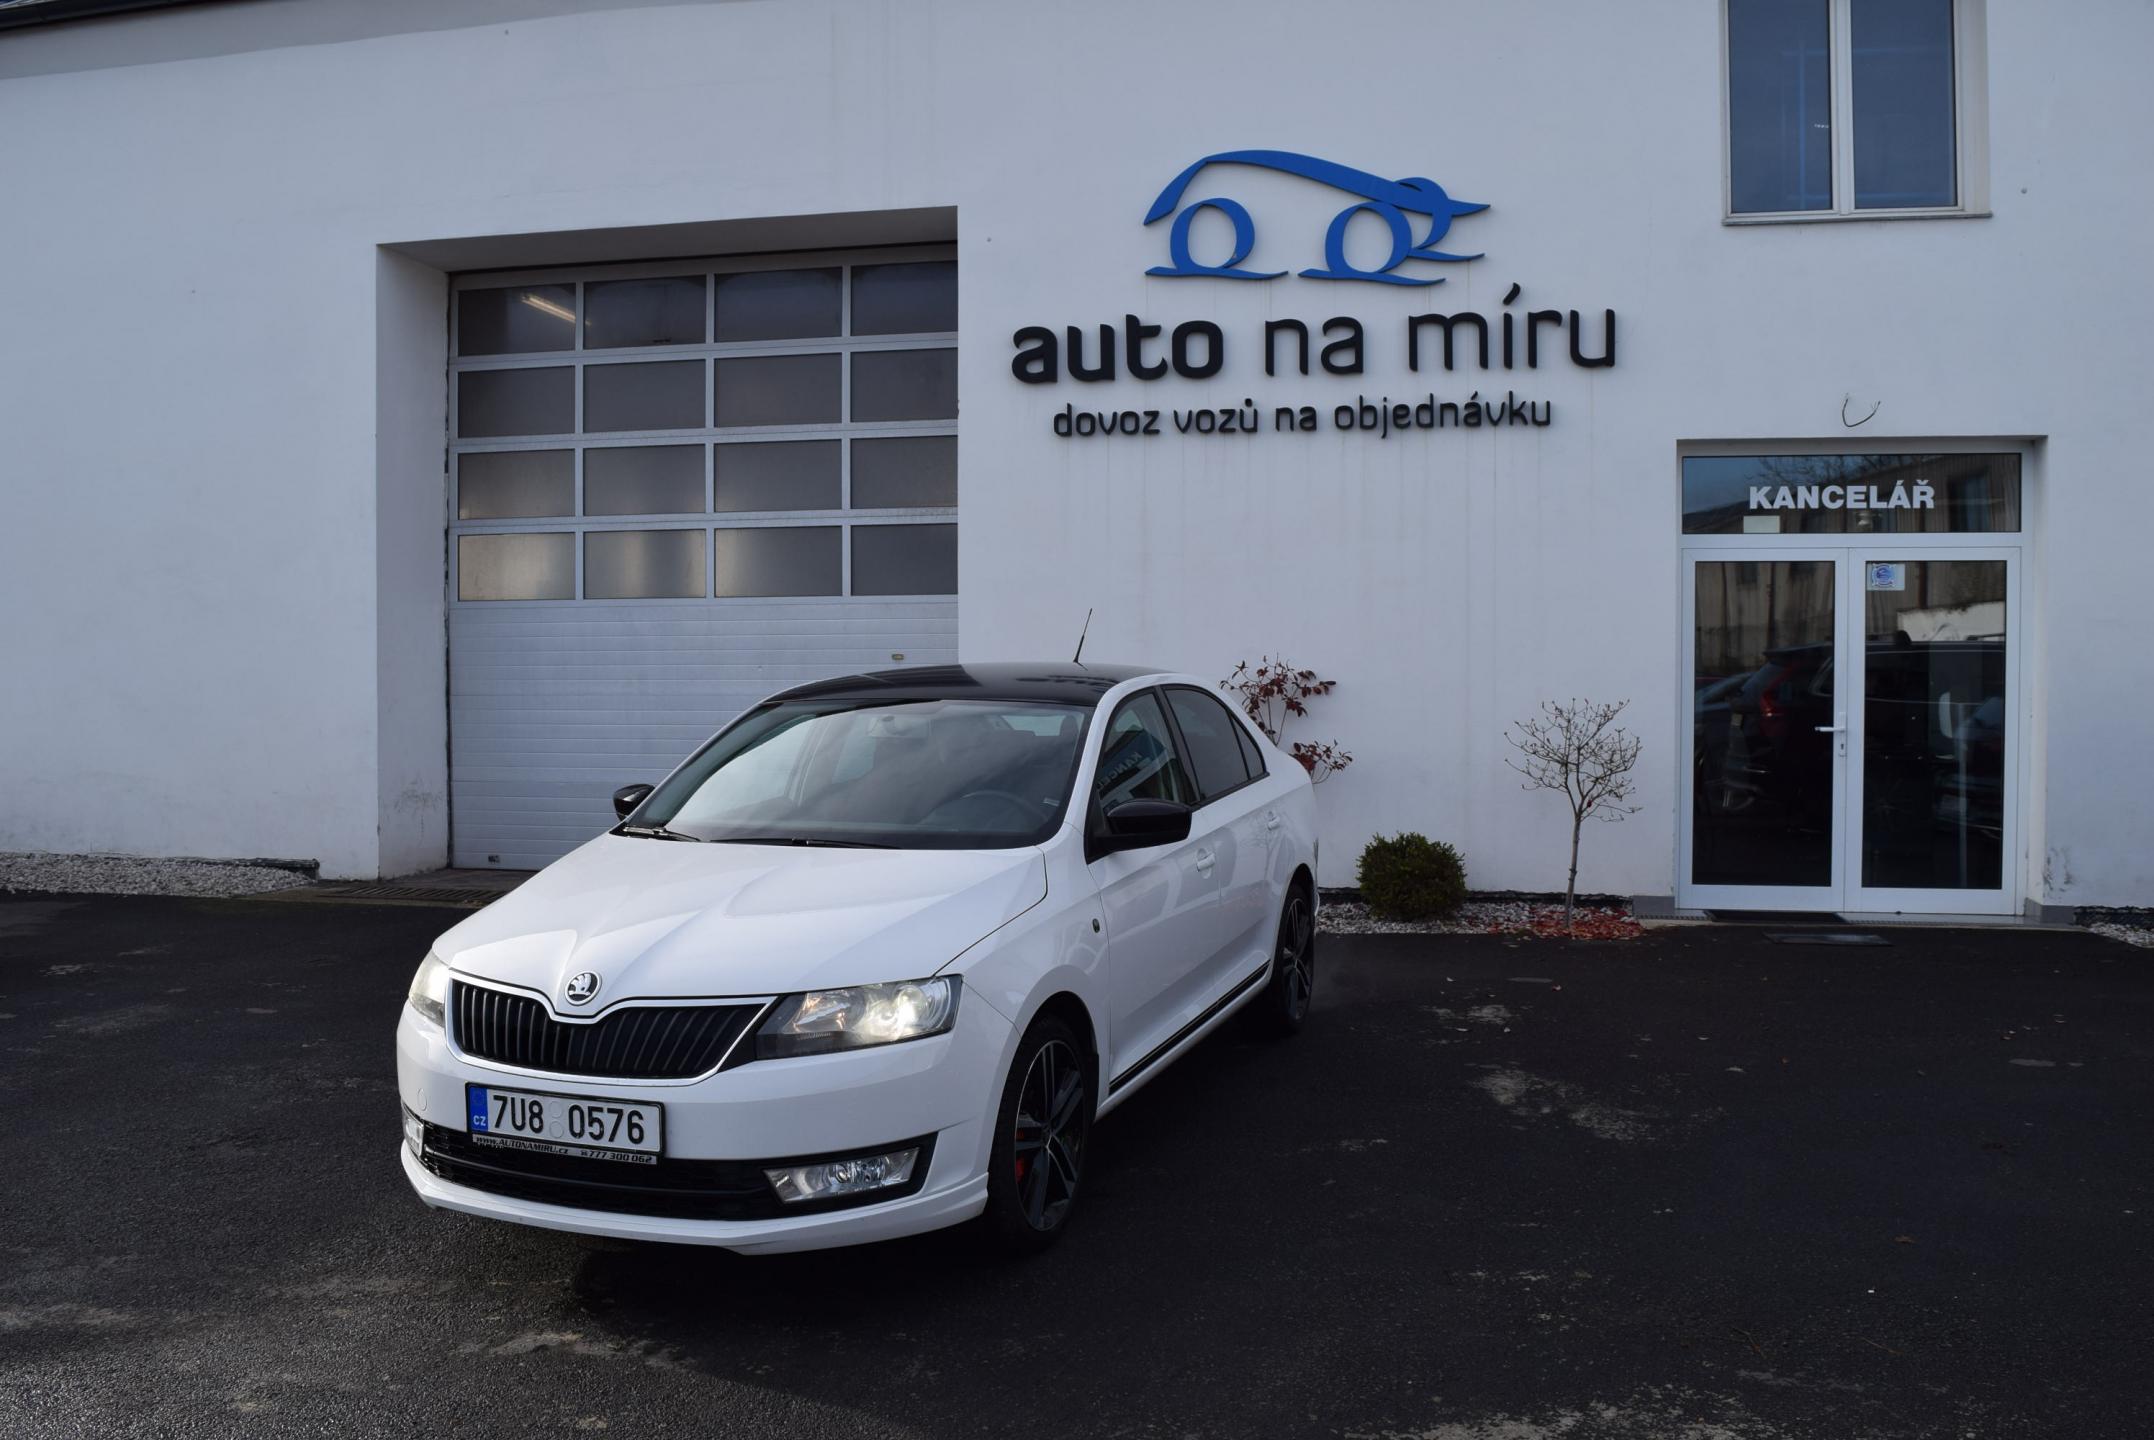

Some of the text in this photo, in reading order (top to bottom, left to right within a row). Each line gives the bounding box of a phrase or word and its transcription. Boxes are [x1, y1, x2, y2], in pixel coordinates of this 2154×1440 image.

[1011, 283, 1617, 384] auto na míru
[1053, 391, 1552, 439] dovoz vozů na objednávku
[1749, 479, 1935, 509] KANCELÁŘ
[473, 1115, 486, 1127] CZ
[493, 1095, 645, 1145] 7U8 0576
[589, 1151, 606, 1160] 777
[610, 1153, 629, 1162] 300
